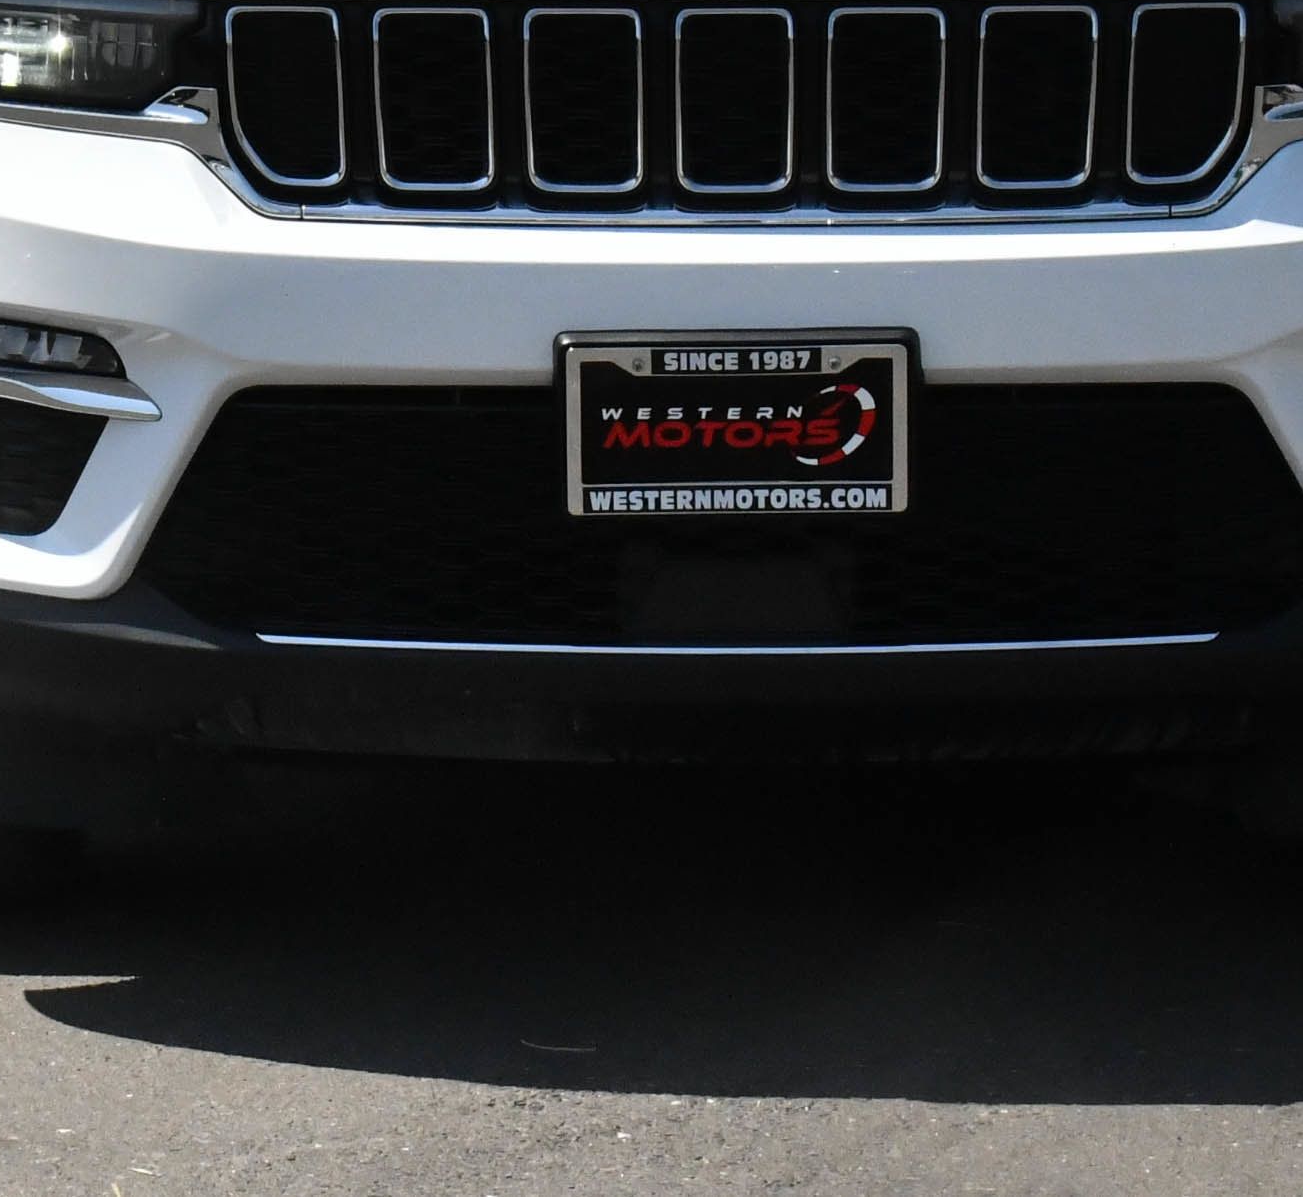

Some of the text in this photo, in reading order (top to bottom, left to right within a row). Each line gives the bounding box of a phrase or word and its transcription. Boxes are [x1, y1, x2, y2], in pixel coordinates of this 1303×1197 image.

[663, 350, 811, 372] SINCE 1987
[601, 405, 803, 421] WESTERN
[603, 420, 839, 449] MOTORS
[590, 488, 887, 511] WESTERNMOTORS.COM
